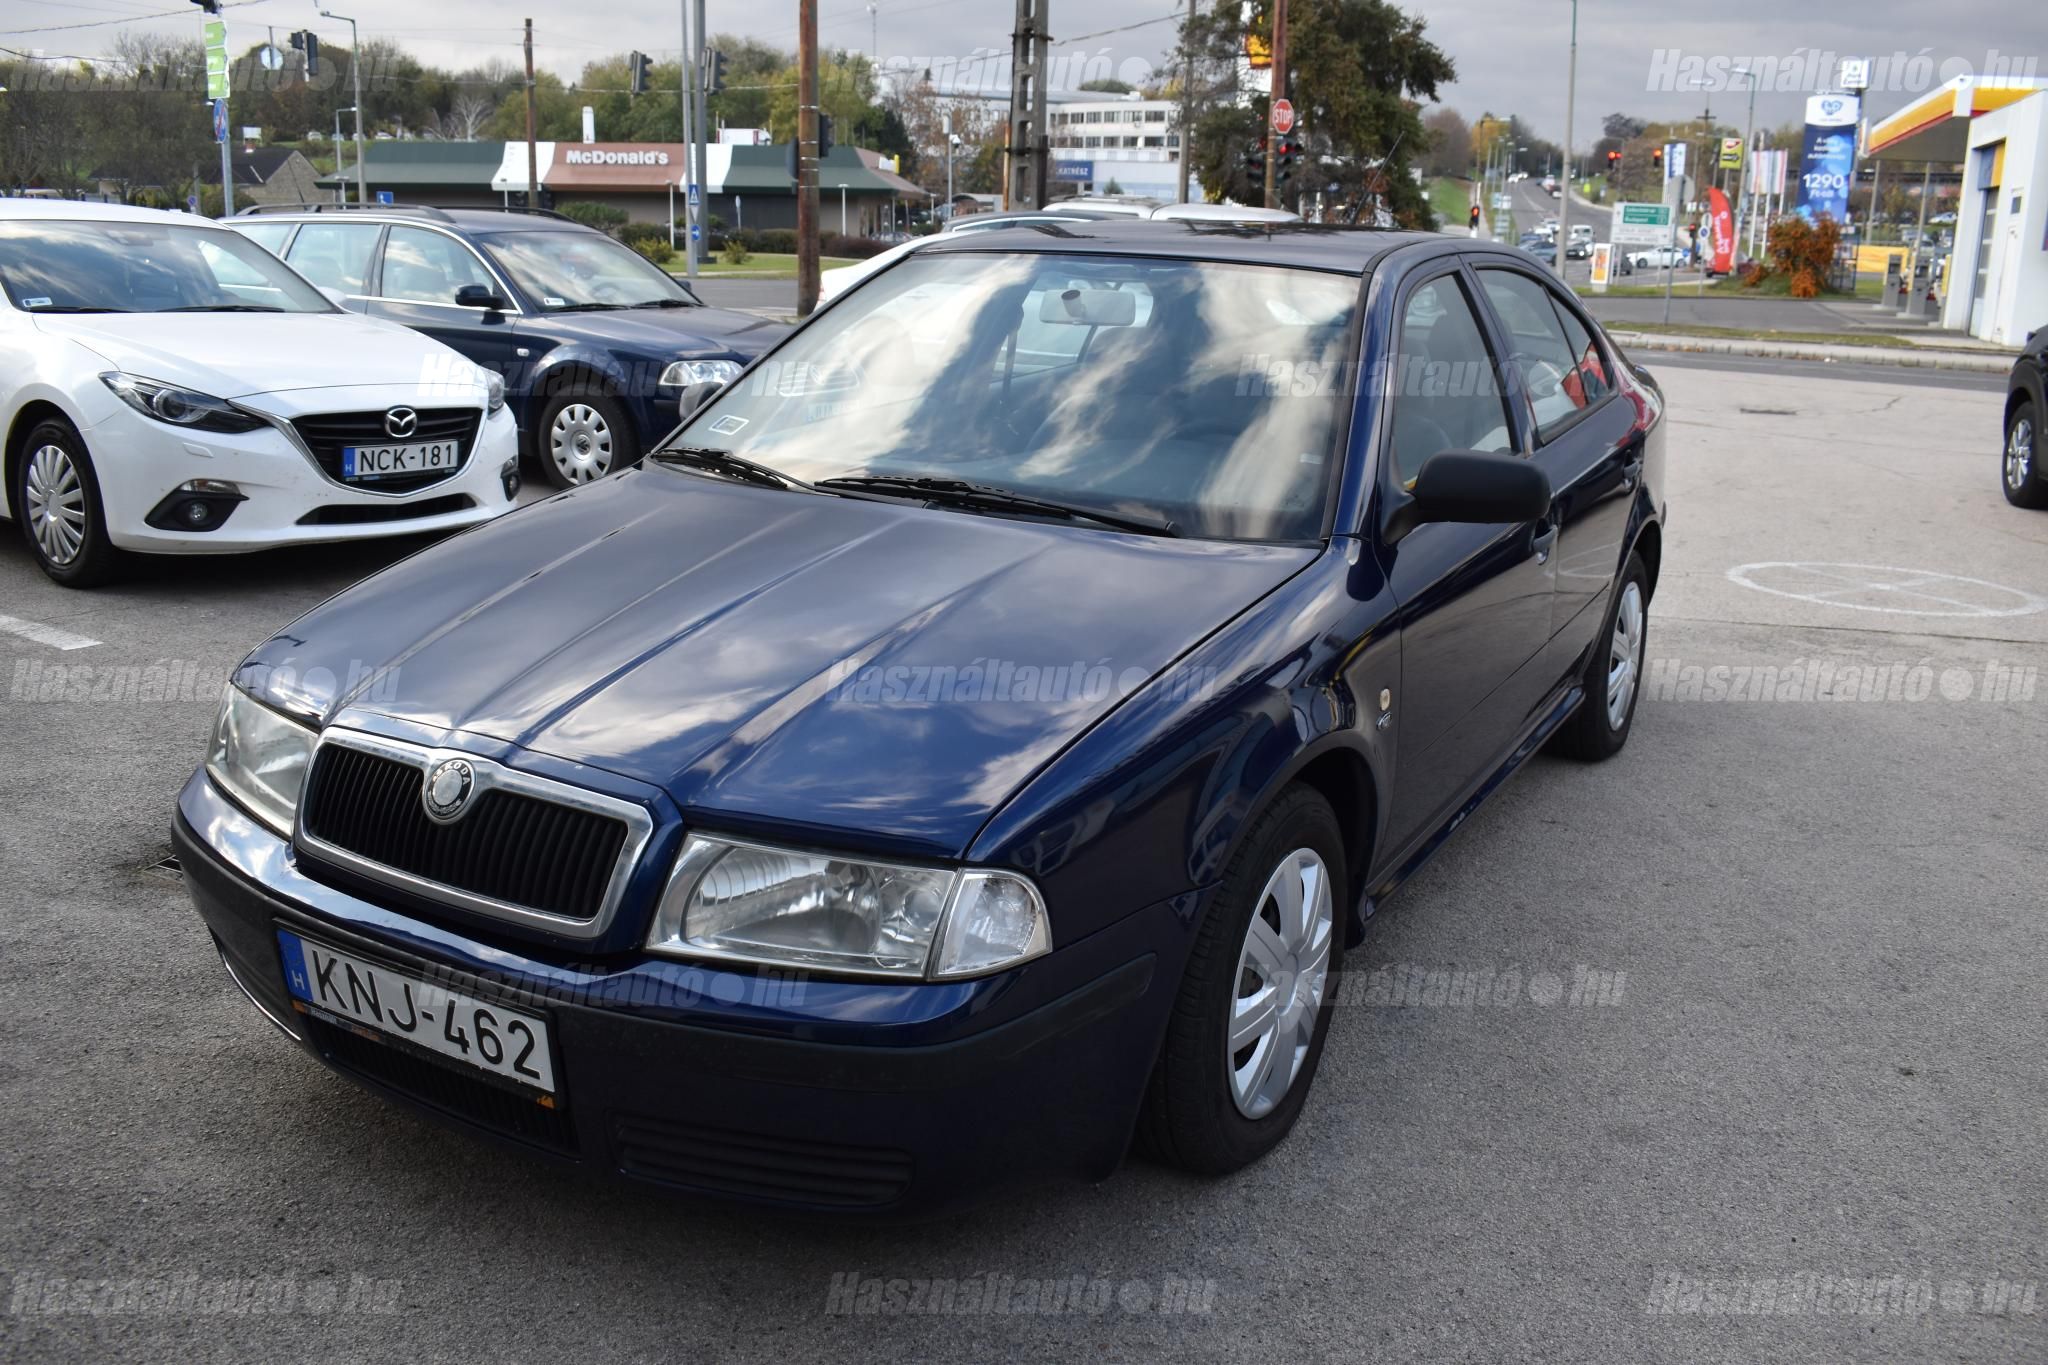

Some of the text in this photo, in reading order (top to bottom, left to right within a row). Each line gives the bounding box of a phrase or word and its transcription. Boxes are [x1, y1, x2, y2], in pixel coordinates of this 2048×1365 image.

[1275, 108, 1292, 125] STOP
[566, 150, 669, 165] McDonald's
[1056, 166, 1089, 176] KATRÉSZ
[1803, 173, 1845, 190] 1290
[359, 443, 453, 473] NCK-181
[290, 949, 542, 1082] H KNJ-462
